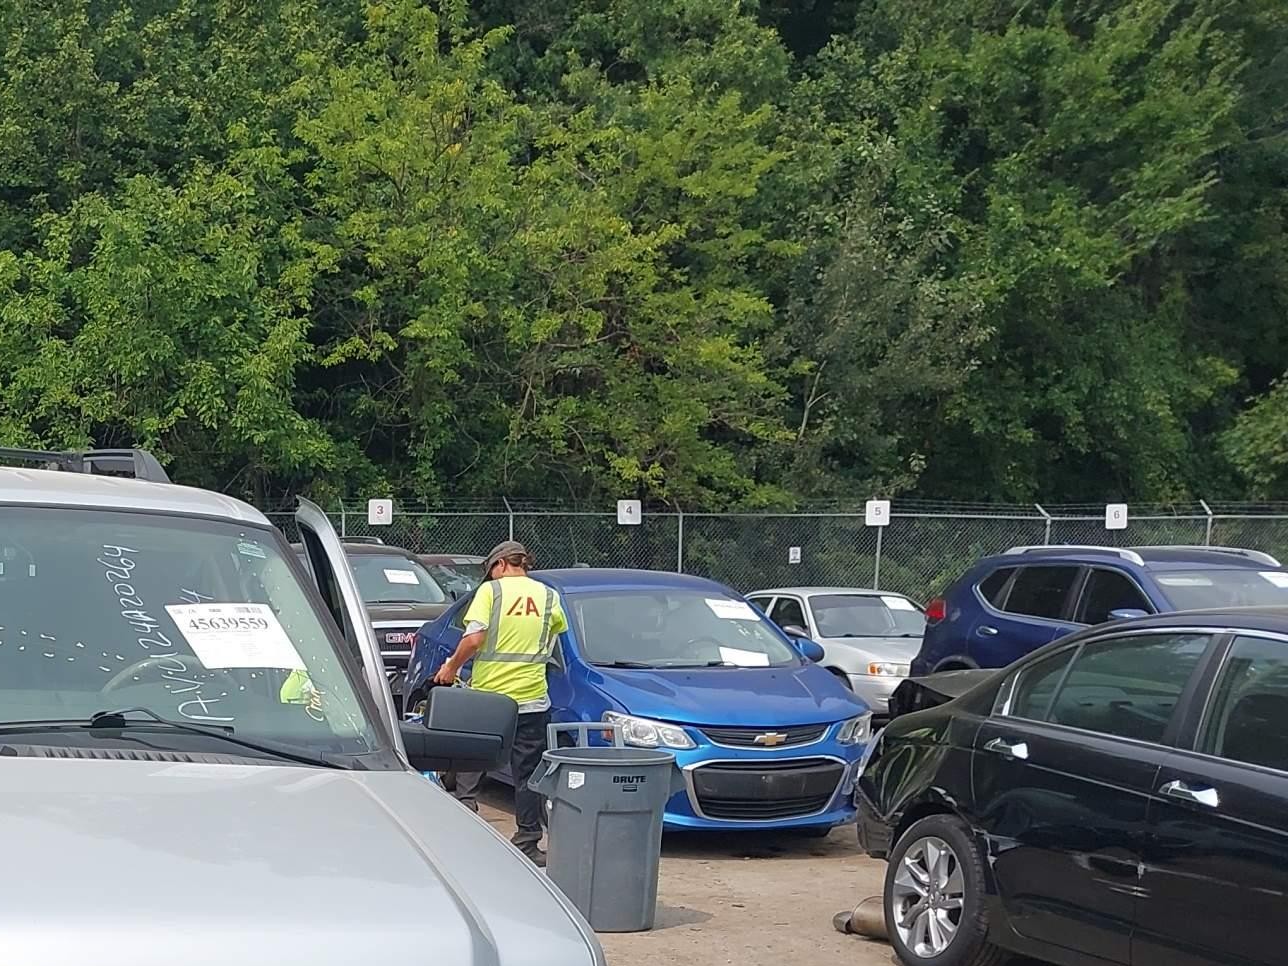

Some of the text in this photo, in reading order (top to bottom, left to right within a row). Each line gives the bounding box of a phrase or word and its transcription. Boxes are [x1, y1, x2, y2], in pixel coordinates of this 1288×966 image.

[376, 505, 384, 515] 3
[625, 505, 633, 515] 4
[874, 506, 882, 516] 5
[1113, 510, 1120, 520] 6
[189, 617, 269, 630] 45639559
[385, 633, 416, 644] GM
[612, 775, 647, 784] BRUTE
